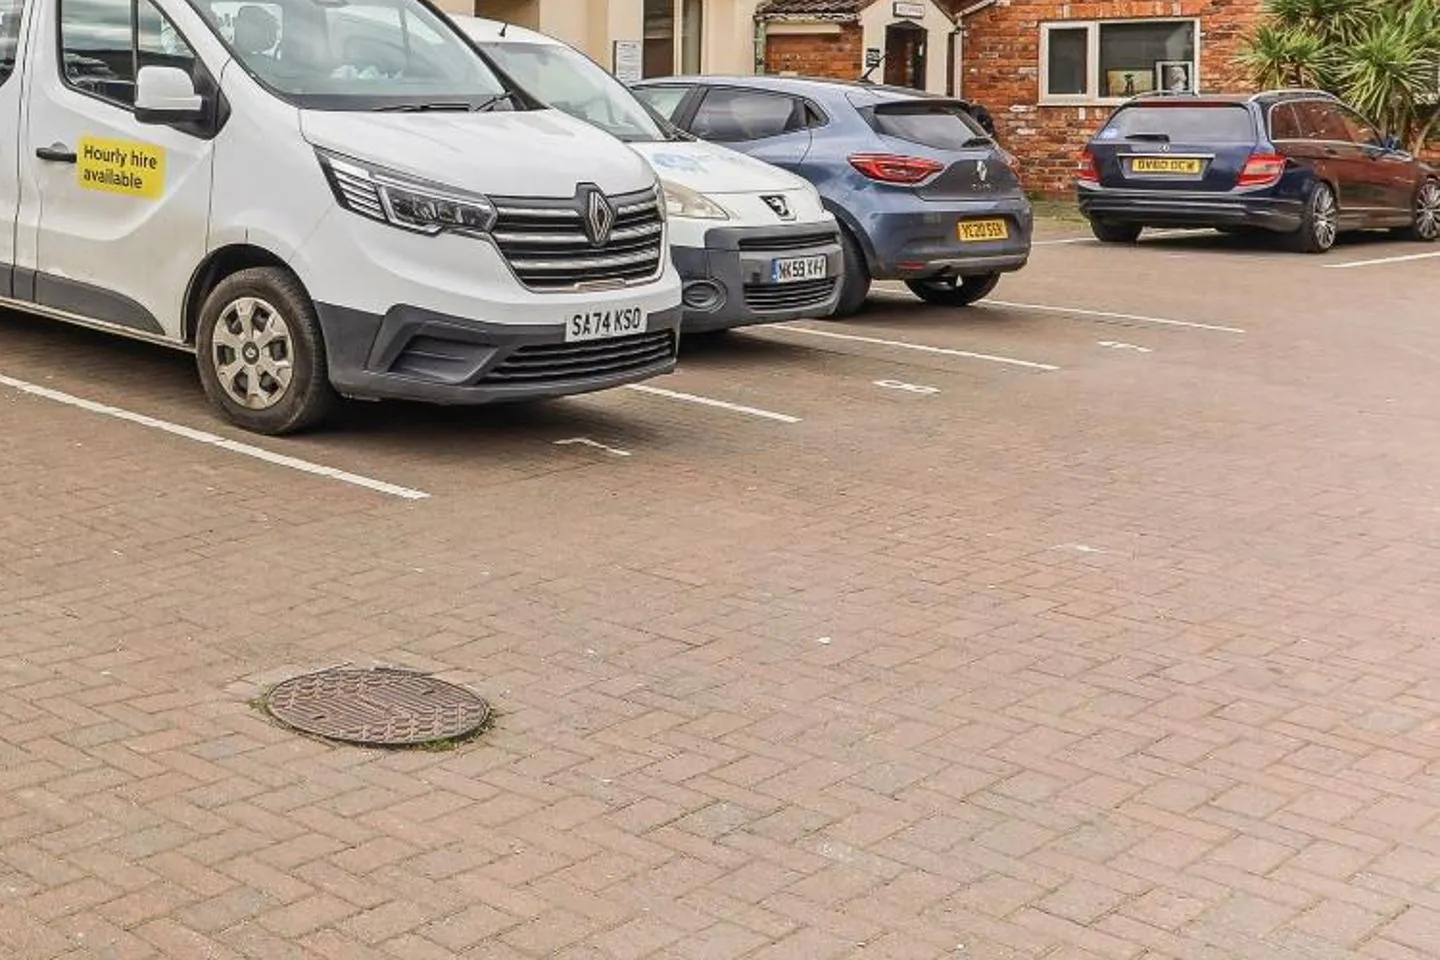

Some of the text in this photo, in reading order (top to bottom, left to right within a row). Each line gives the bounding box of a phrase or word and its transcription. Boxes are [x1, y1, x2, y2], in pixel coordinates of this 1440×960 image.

[83, 145, 157, 169] Hourly hire
[83, 168, 143, 189] available
[572, 307, 641, 336] SA74 KSO
